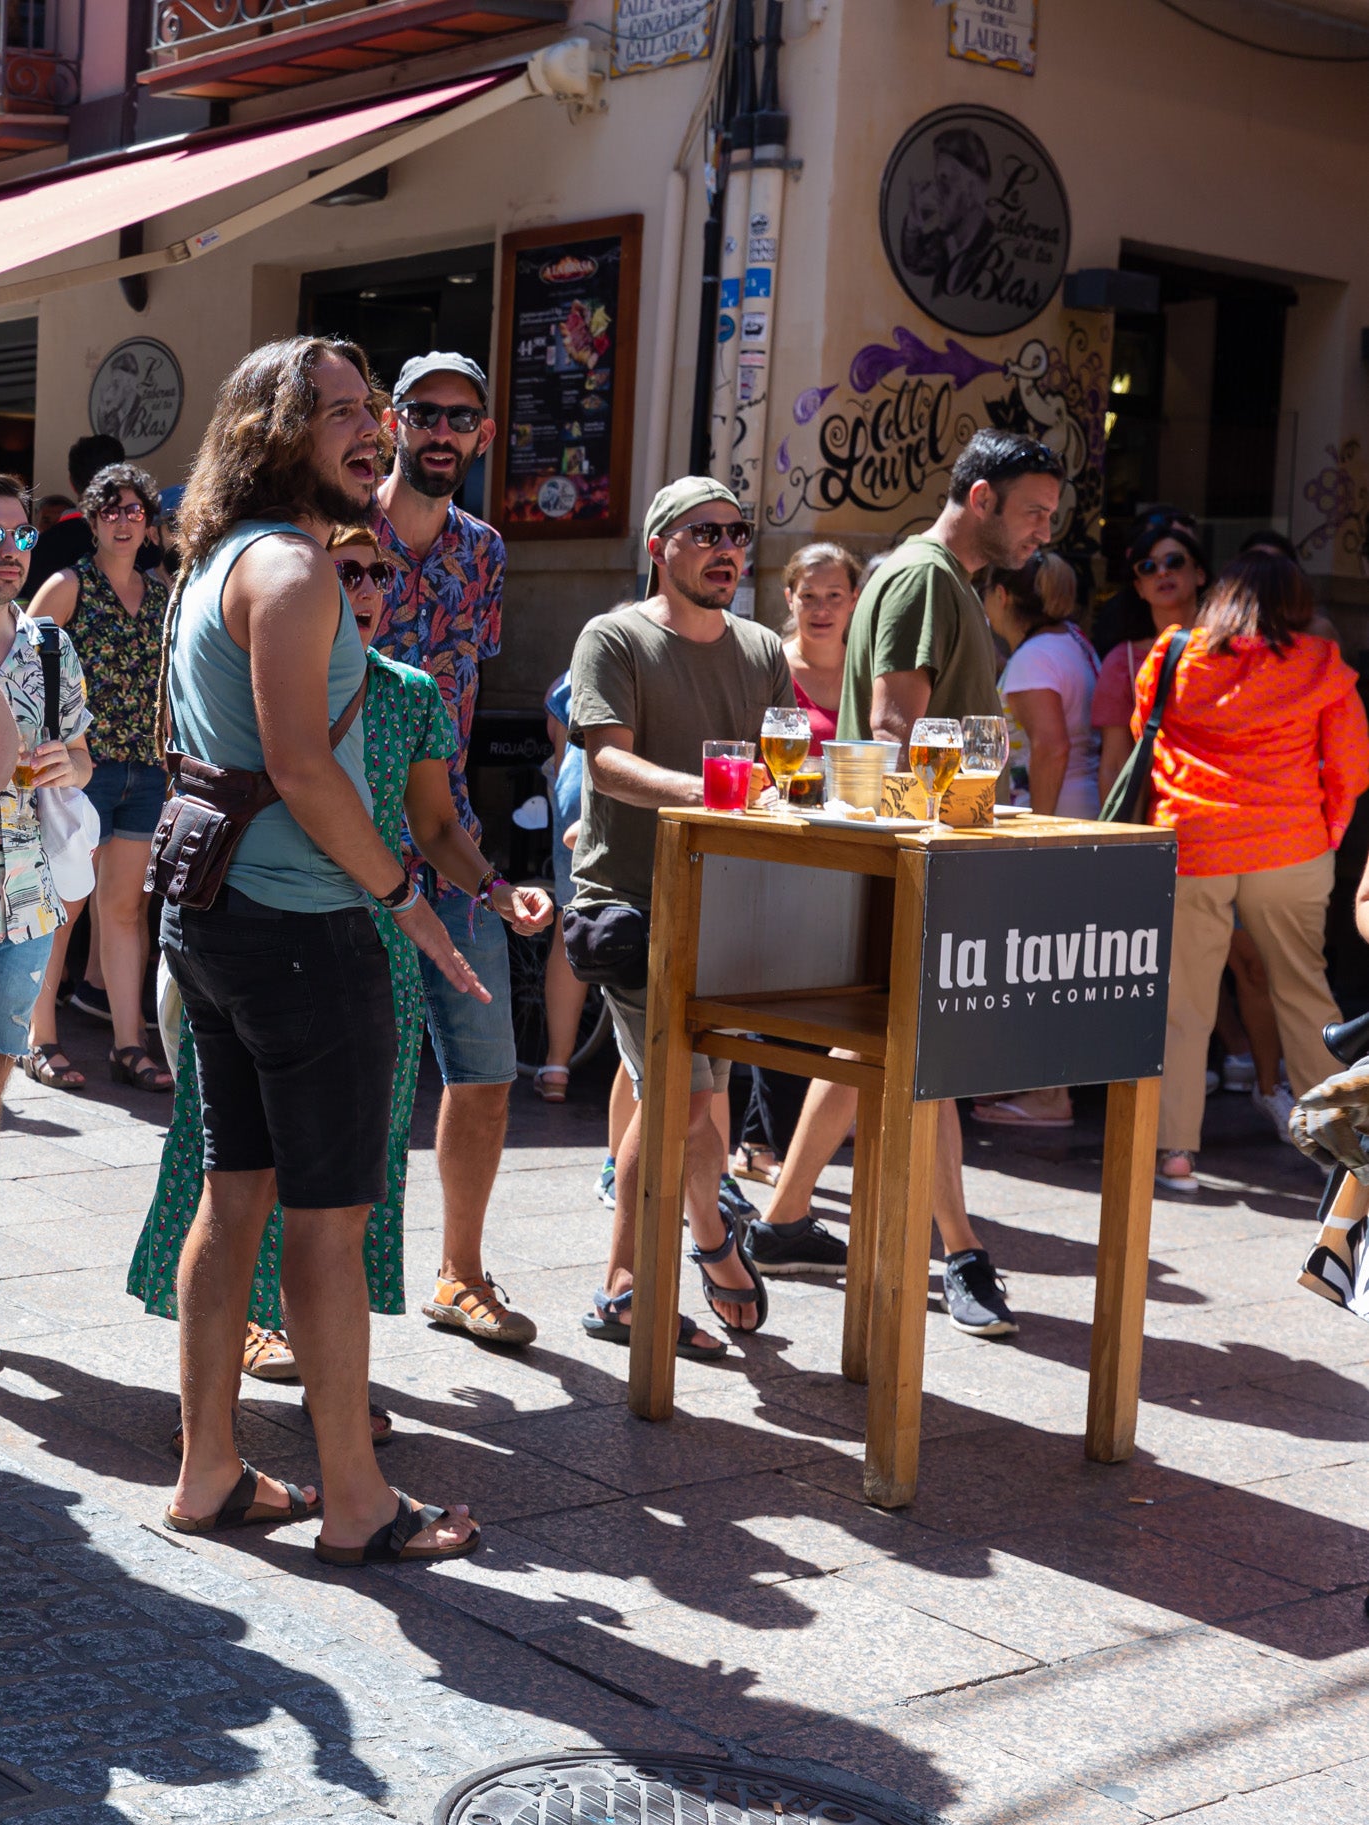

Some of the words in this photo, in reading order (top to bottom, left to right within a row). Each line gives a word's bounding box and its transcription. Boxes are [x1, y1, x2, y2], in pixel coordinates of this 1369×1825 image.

[626, 31, 698, 60] GALLARZA
[964, 19, 1022, 58] LAUREL
[938, 933, 987, 989] la
[1005, 923, 1159, 985] tavina
[938, 994, 1011, 1013] VINOS
[1027, 992, 1036, 1006] Y
[1052, 982, 1155, 1004] COMIDAS
